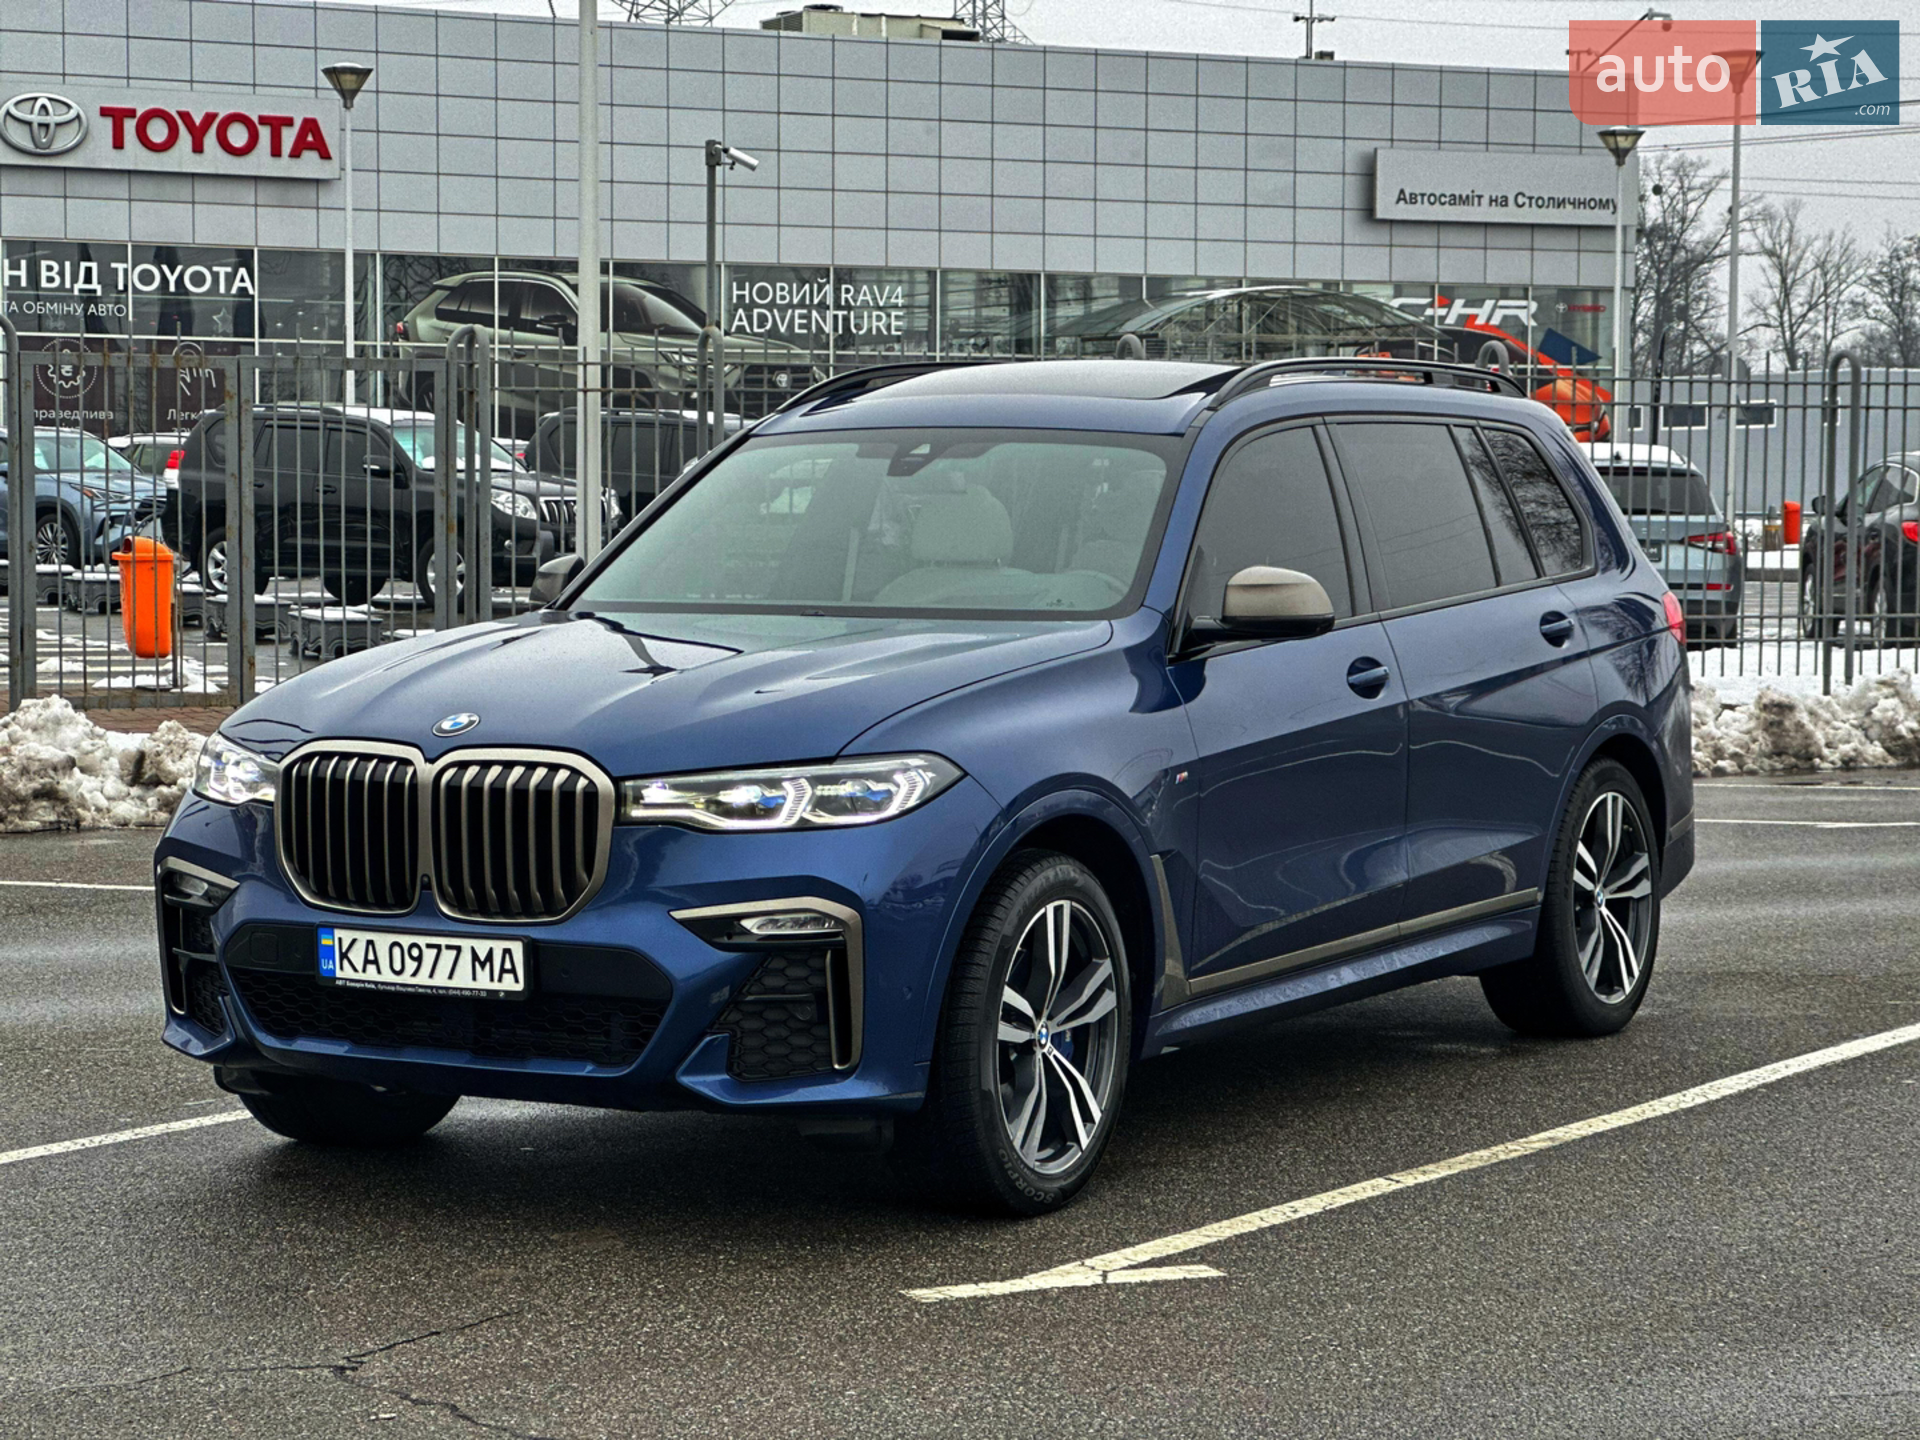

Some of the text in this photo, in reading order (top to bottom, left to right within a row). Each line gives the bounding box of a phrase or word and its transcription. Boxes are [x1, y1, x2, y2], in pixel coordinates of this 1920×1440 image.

[99, 105, 333, 160] TOYOTA
[1395, 188, 1618, 215] Автосаміт на Столичному
[40, 259, 103, 296] ВІД
[110, 262, 255, 294] TOYOTA
[732, 278, 905, 307] НОВИЙ RAV4
[22, 301, 84, 316] ОБМІНУ
[87, 303, 127, 317] АВТО
[730, 308, 905, 336] ADVENTURE
[321, 959, 334, 970] UA
[337, 936, 520, 984] KA 0977 MA
